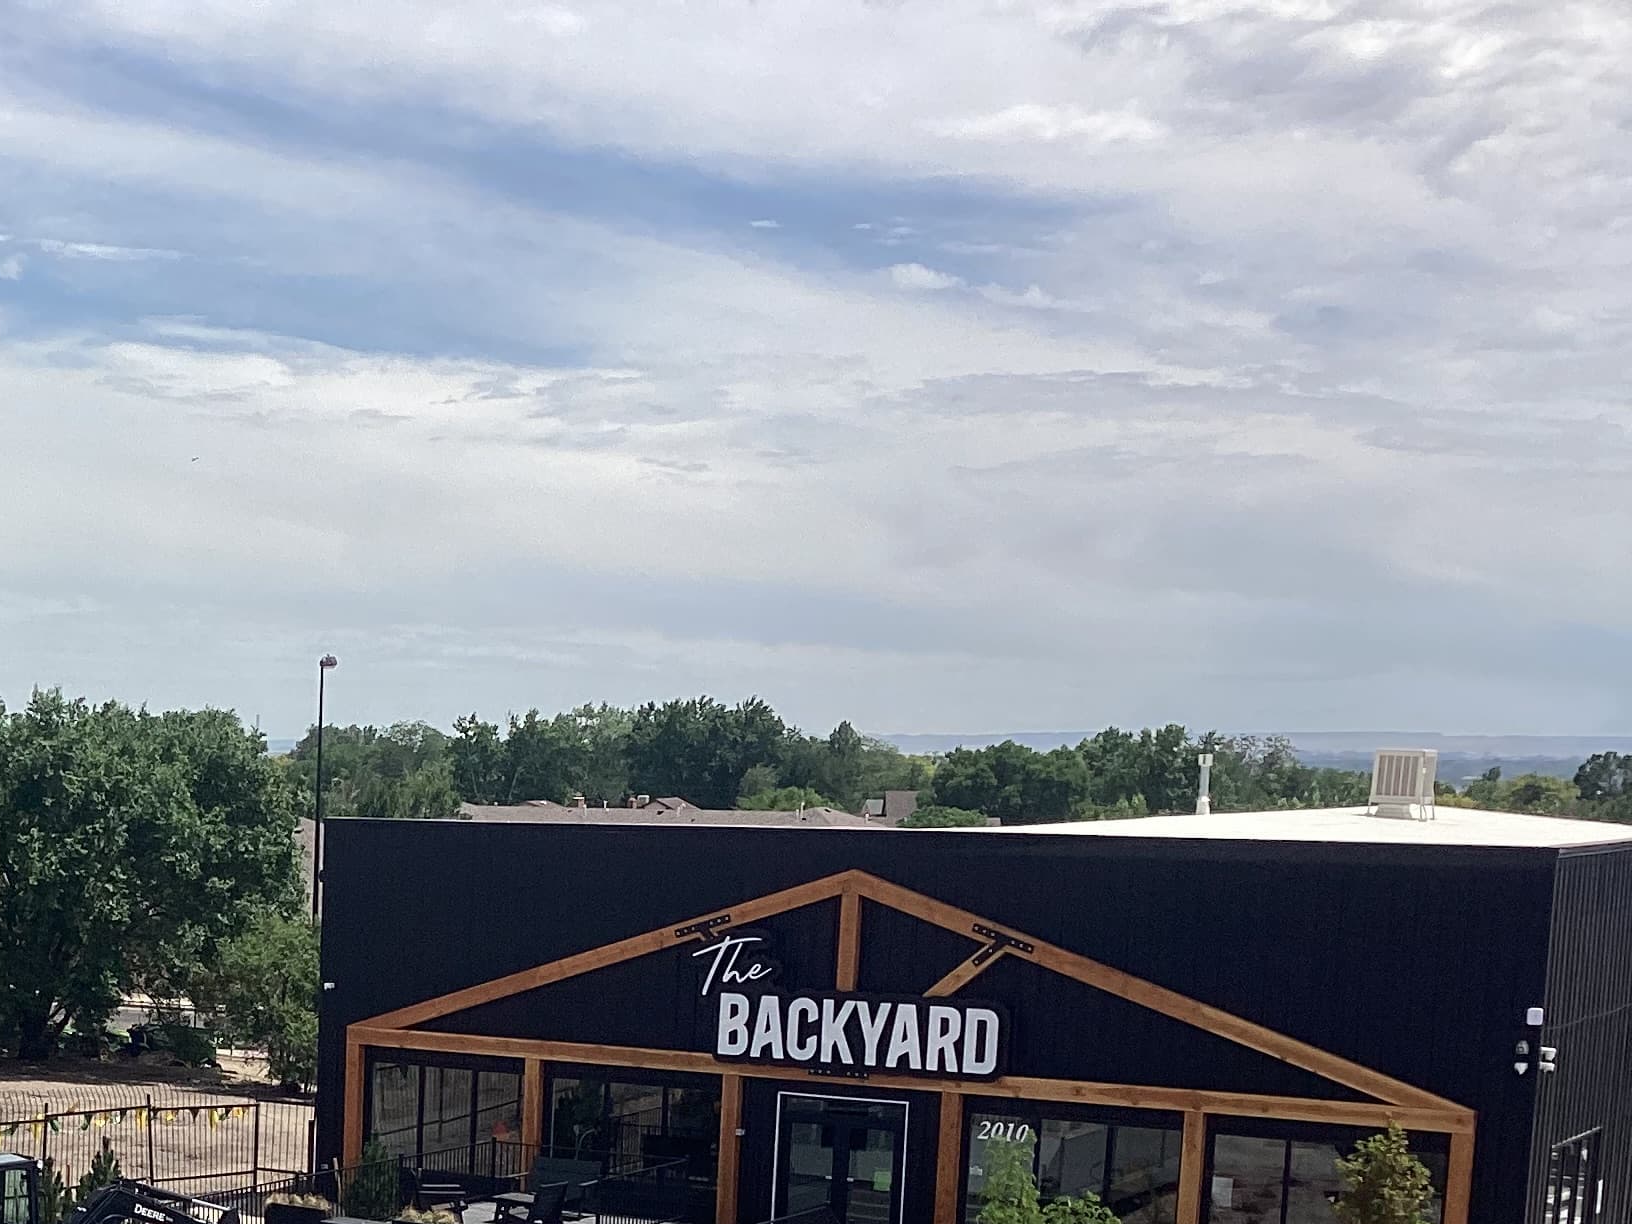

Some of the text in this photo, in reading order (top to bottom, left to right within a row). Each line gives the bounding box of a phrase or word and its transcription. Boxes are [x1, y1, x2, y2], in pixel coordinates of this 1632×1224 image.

[692, 935, 773, 997] The
[717, 992, 1001, 1076] BACKYARD
[977, 1121, 1029, 1142] 2010
[134, 1203, 165, 1222] DEERE
